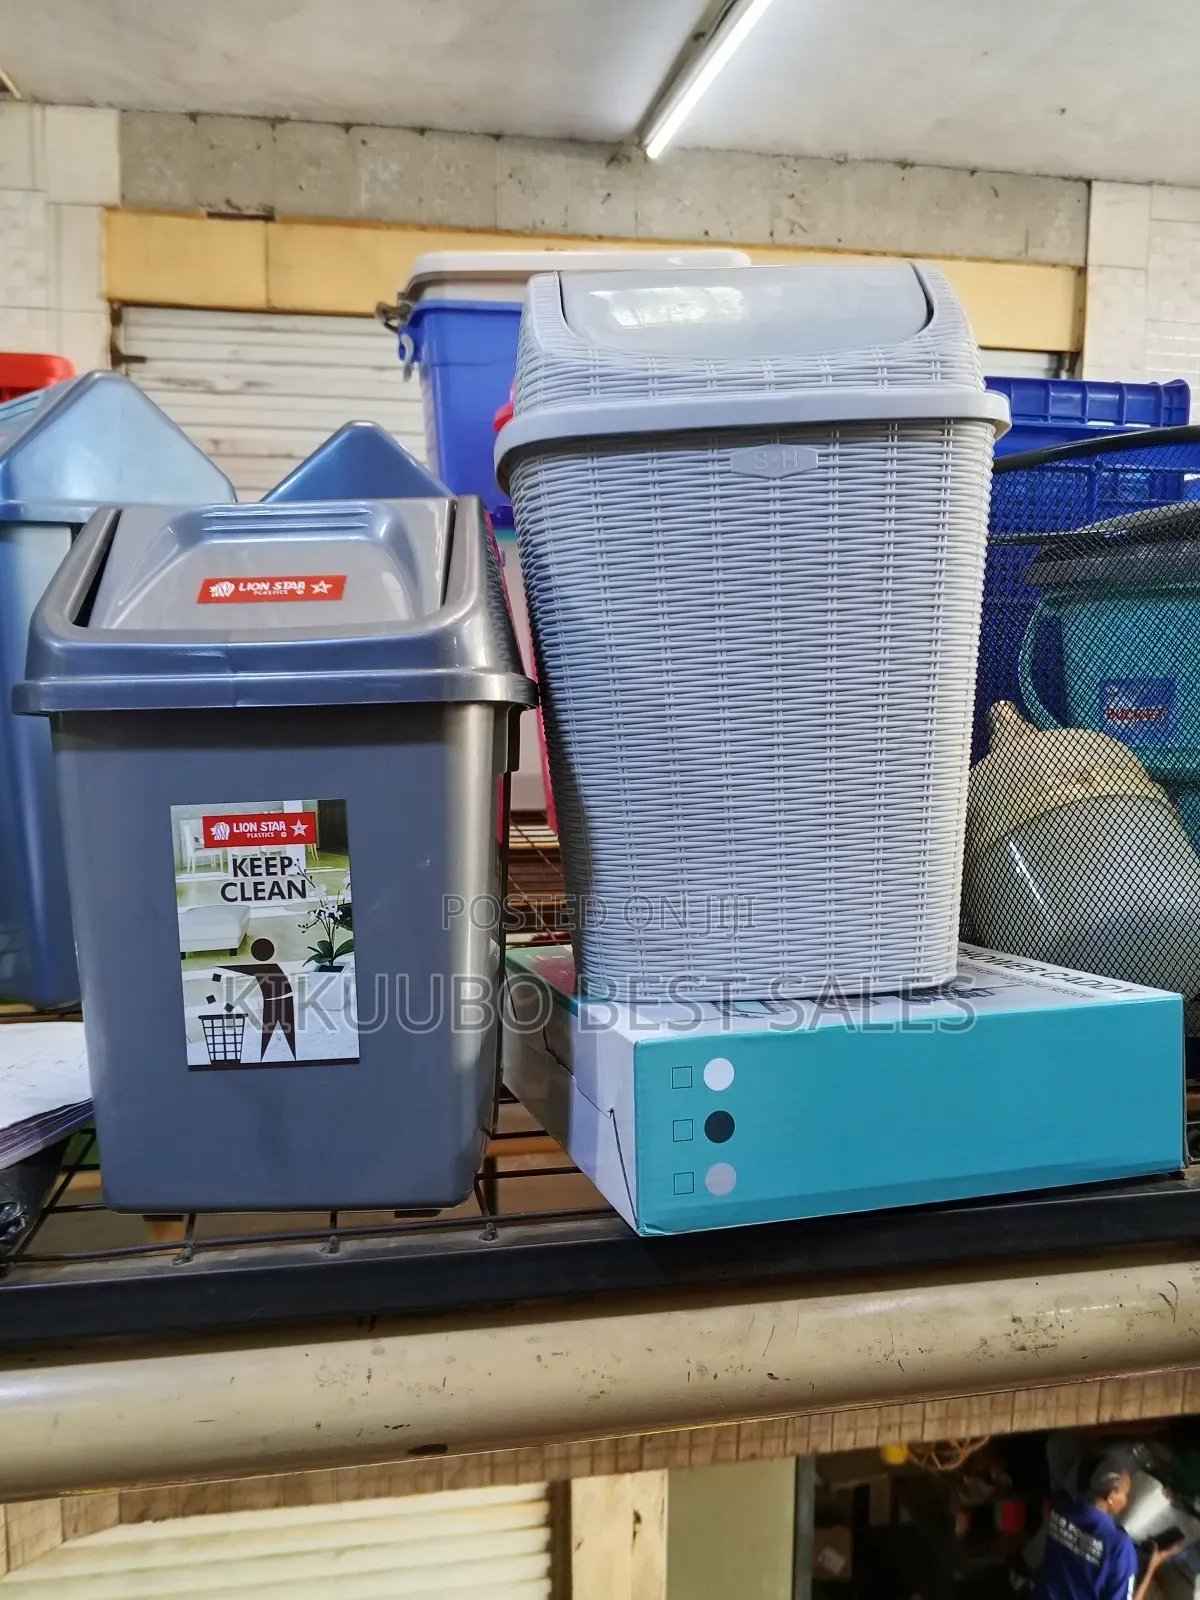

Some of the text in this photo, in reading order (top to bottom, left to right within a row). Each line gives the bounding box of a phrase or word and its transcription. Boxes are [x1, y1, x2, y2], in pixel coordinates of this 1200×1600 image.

[238, 580, 306, 592] LION STAR
[232, 820, 287, 833] LION STAR
[246, 831, 275, 839] PLASTICS
[232, 856, 293, 878] KEEP
[220, 879, 307, 902] CLEAN
[1039, 971, 1147, 994] CADDY
